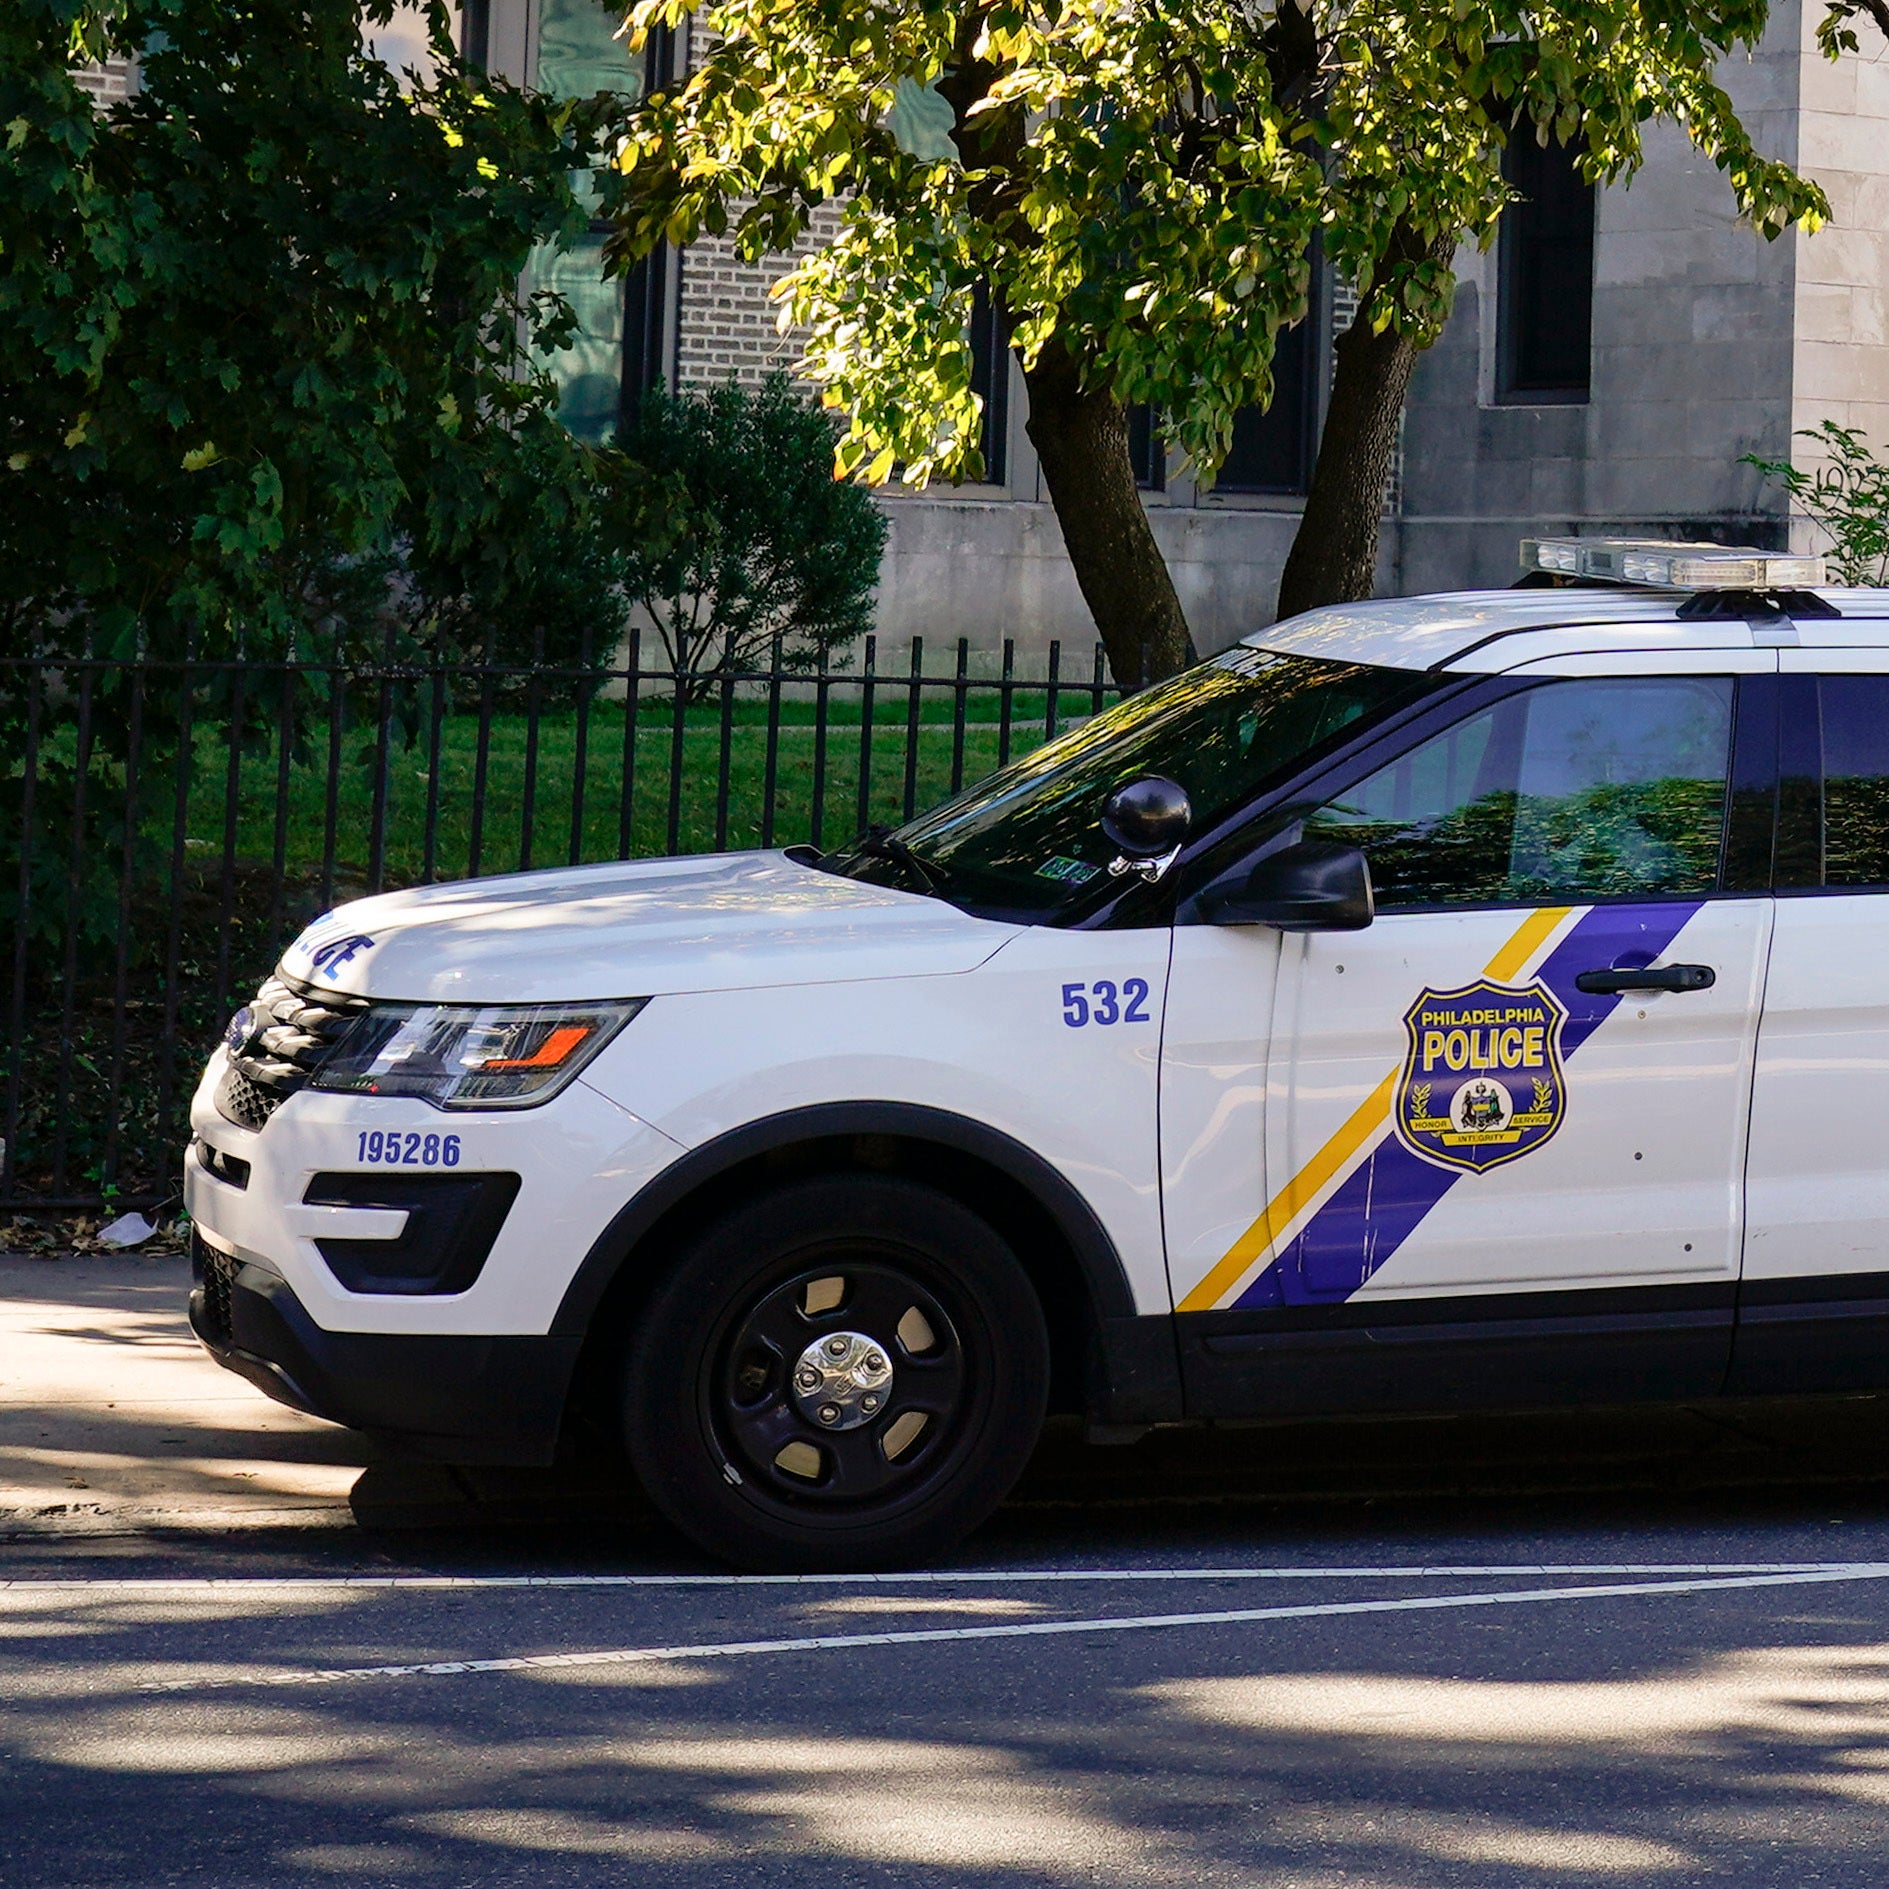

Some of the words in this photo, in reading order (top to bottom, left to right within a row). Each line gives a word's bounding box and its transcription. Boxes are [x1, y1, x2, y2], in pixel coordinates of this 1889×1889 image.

[1061, 978, 1150, 1028] 532
[1421, 1007, 1546, 1027] PHILADELPHIA
[1422, 1026, 1545, 1072] POLICE
[1414, 1120, 1448, 1129] HONOR
[1512, 1115, 1550, 1125] SERVICE
[357, 1130, 461, 1167] 195286
